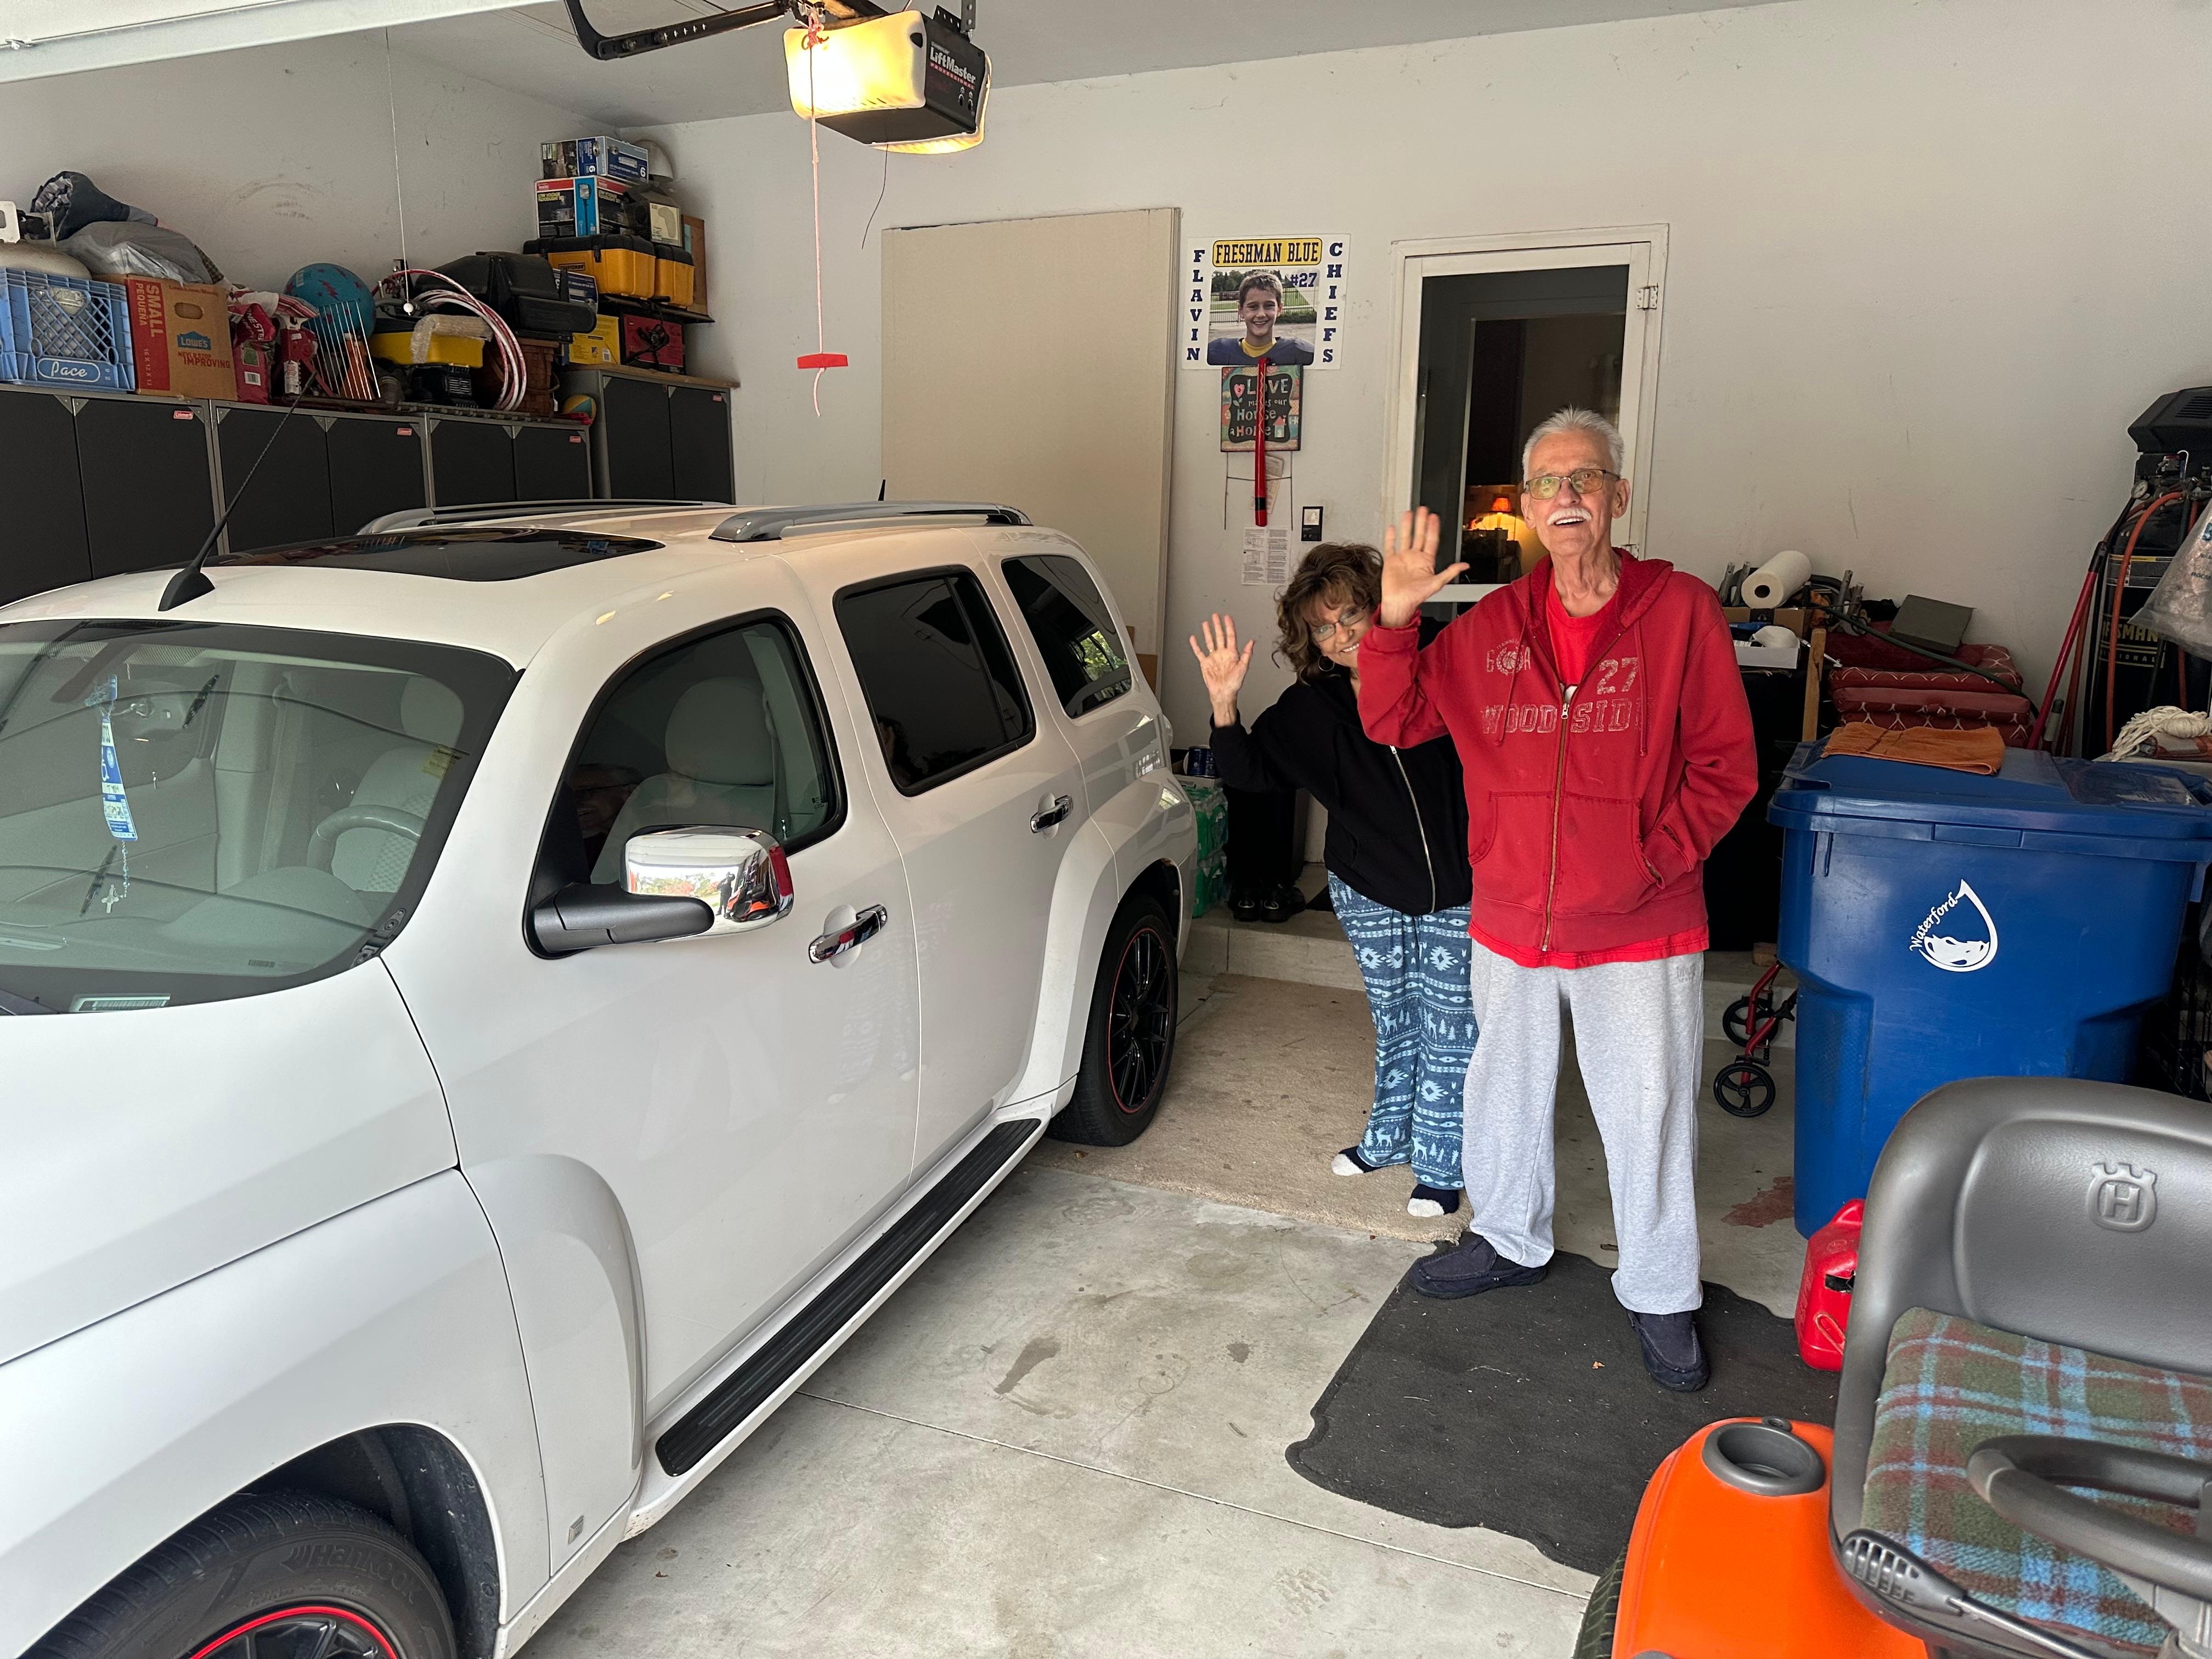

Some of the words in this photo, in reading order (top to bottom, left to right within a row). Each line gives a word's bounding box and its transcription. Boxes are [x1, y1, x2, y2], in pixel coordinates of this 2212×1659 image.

[930, 46, 976, 83] LiftMaster
[930, 62, 975, 91] PROFESSIONAL
[640, 167, 646, 177] 6
[1215, 242, 1282, 263] FRESHMAN
[1287, 241, 1319, 262] BLUE
[1290, 272, 1317, 287] #27
[136, 283, 149, 326] PEQUEÑA
[145, 284, 163, 337] SMALL
[1187, 250, 1205, 360] FLAVIN
[1323, 242, 1343, 363] CHIEFS
[180, 337, 208, 348] LOWE'S
[50, 360, 88, 377] Pace
[184, 356, 230, 369] IMPROVING
[1247, 378, 1289, 394] LVE
[1597, 657, 1638, 695] 27
[1909, 891, 1958, 951] Waterford
